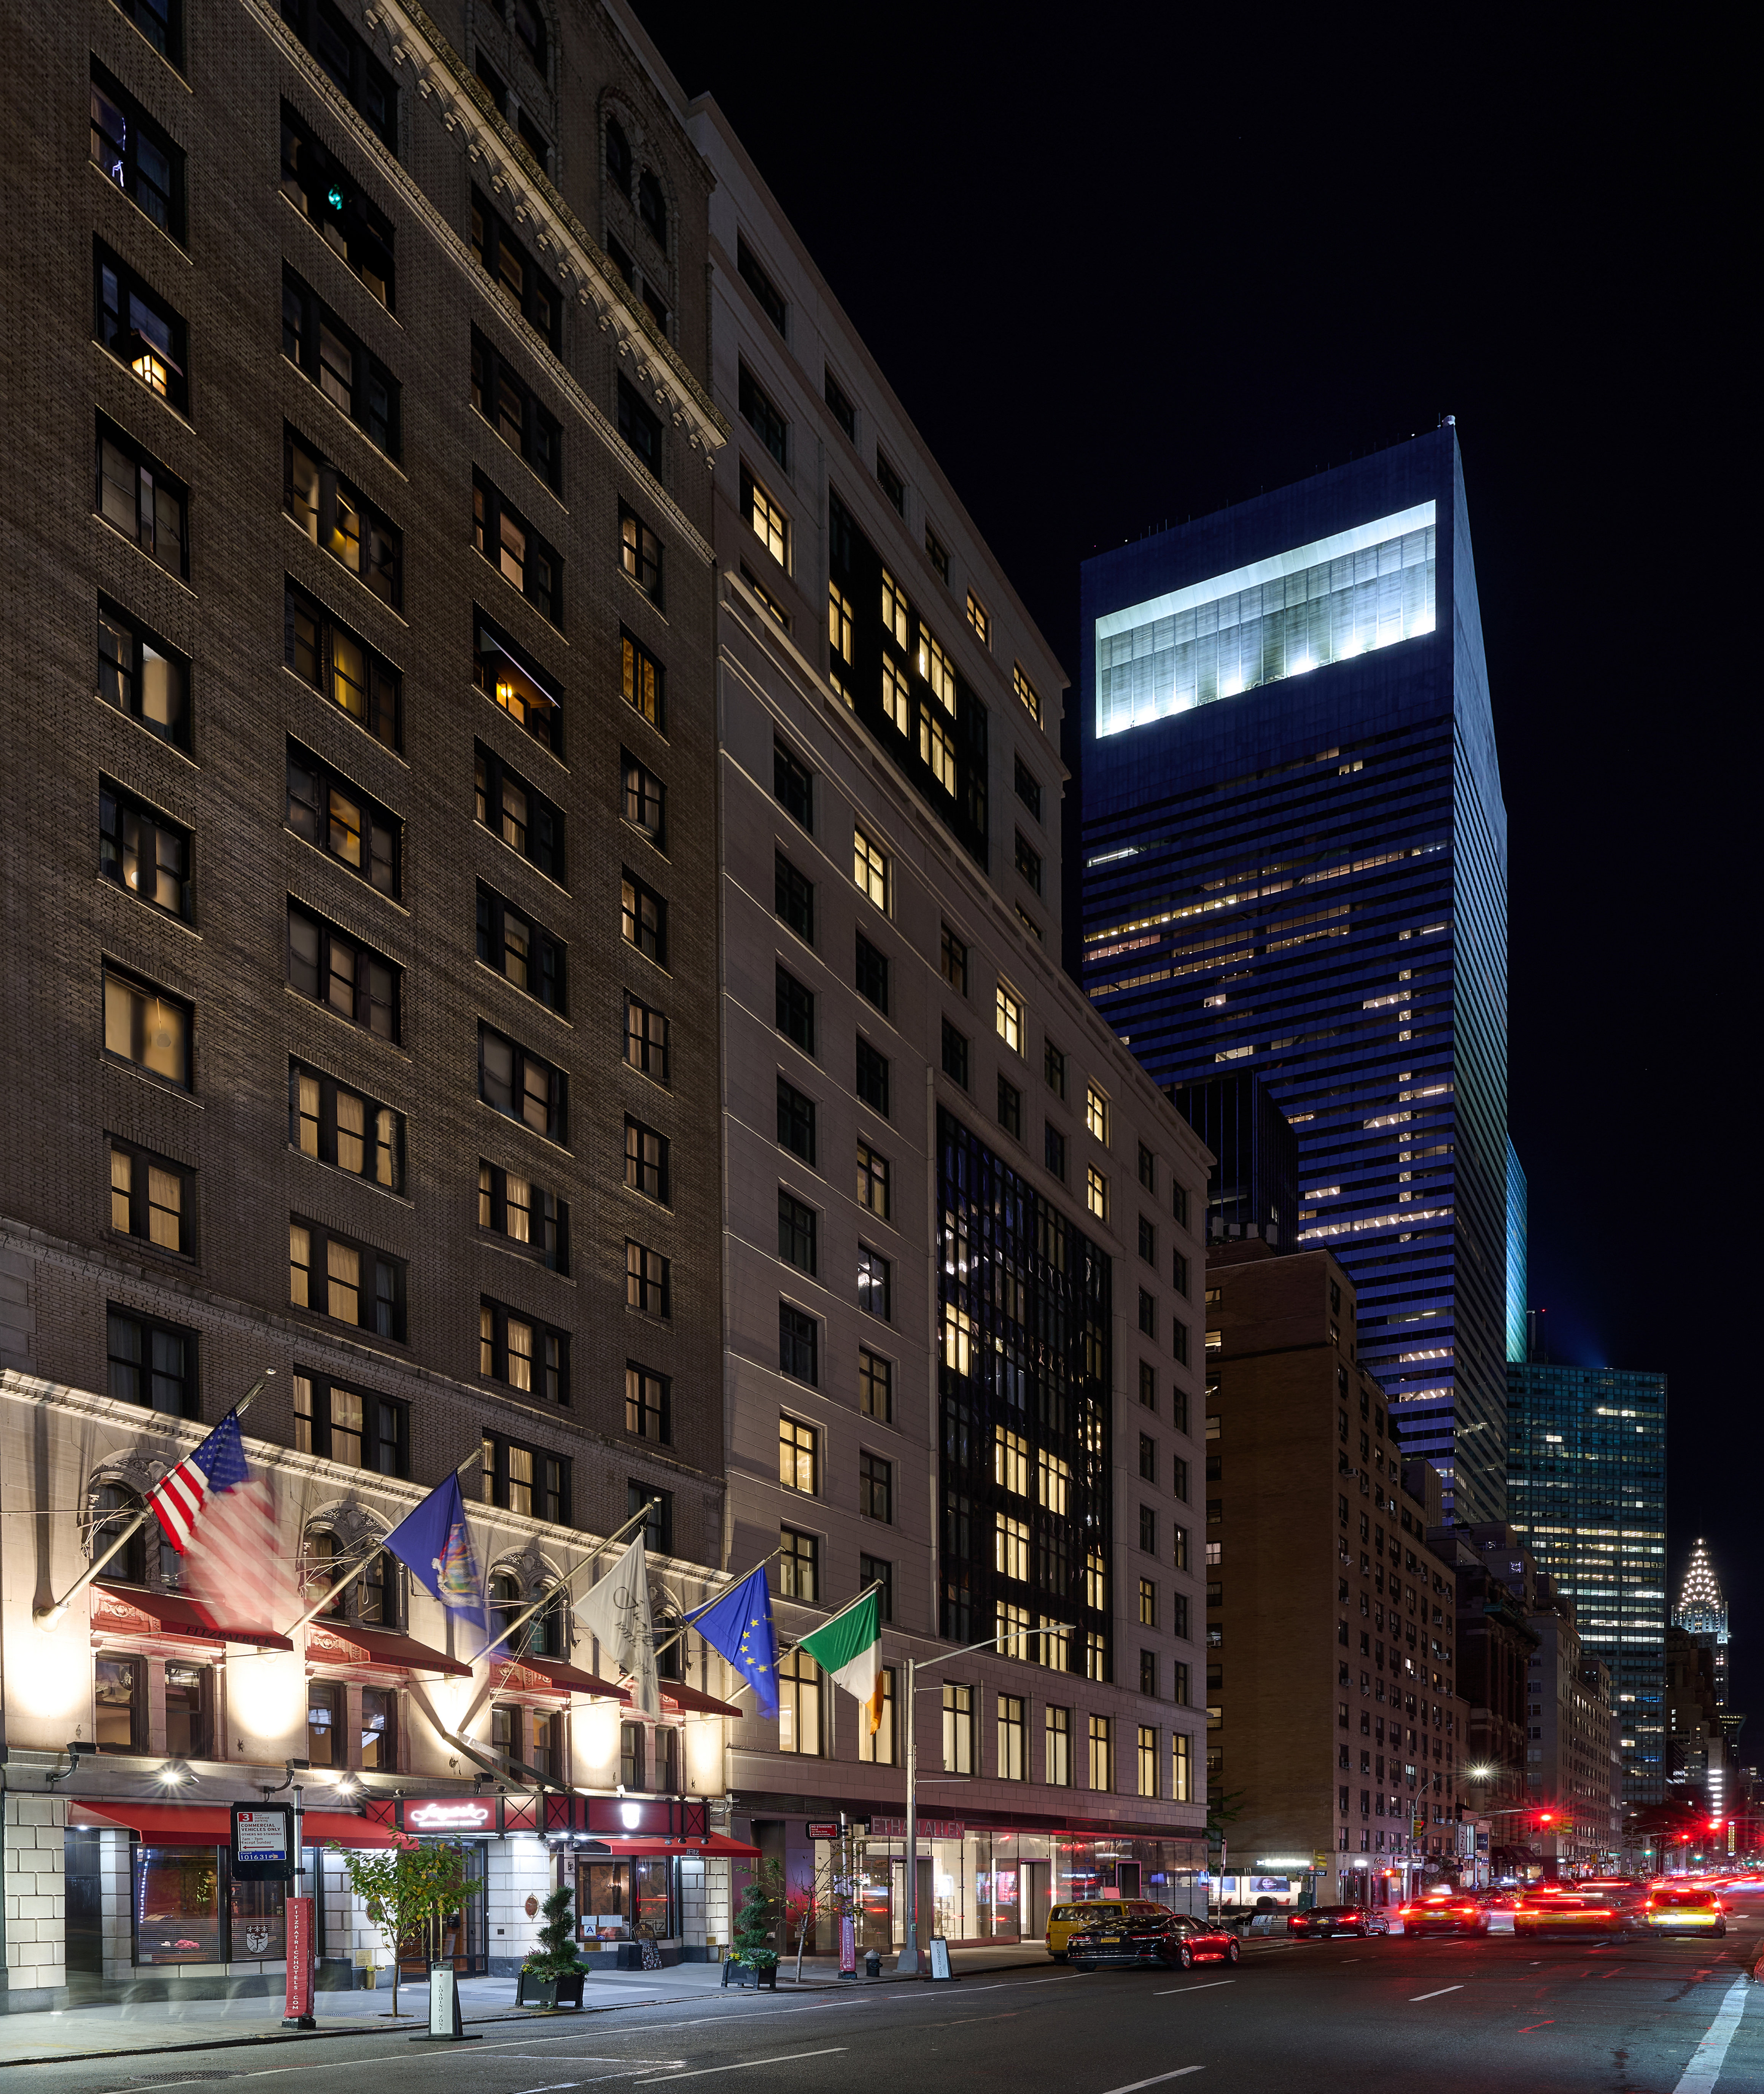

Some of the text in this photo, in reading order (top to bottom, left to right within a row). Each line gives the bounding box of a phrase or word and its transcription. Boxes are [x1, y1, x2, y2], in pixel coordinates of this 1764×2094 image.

[185, 1626, 273, 1646] FITZPATRICK
[389, 1656, 456, 1673] FITZPATRICK
[689, 1704, 732, 1715] FITZPATRICK
[873, 1818, 964, 1837] ETHAN ALLEN
